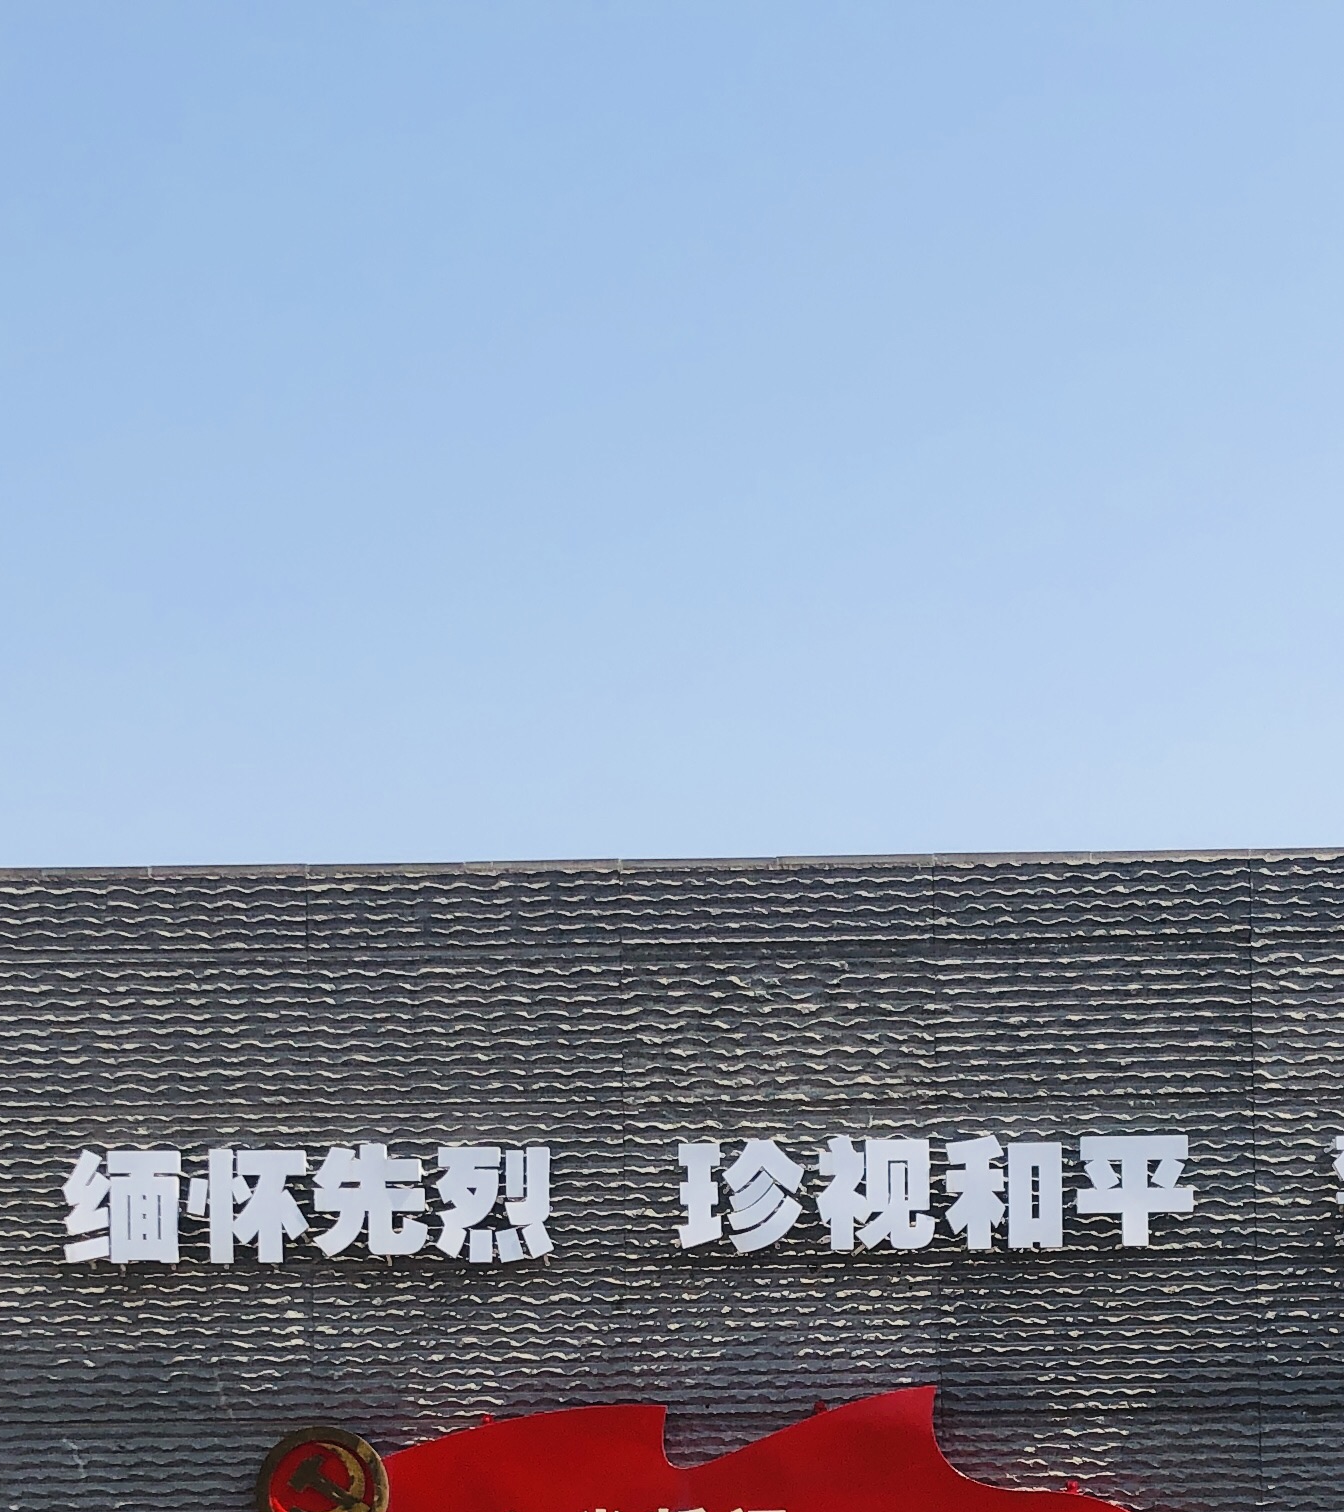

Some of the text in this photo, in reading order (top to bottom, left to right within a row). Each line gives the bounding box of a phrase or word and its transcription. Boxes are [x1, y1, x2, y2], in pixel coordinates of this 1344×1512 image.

[64, 1143, 551, 1265] 缅怀先烈
[677, 1134, 1195, 1255] 珍视和平
